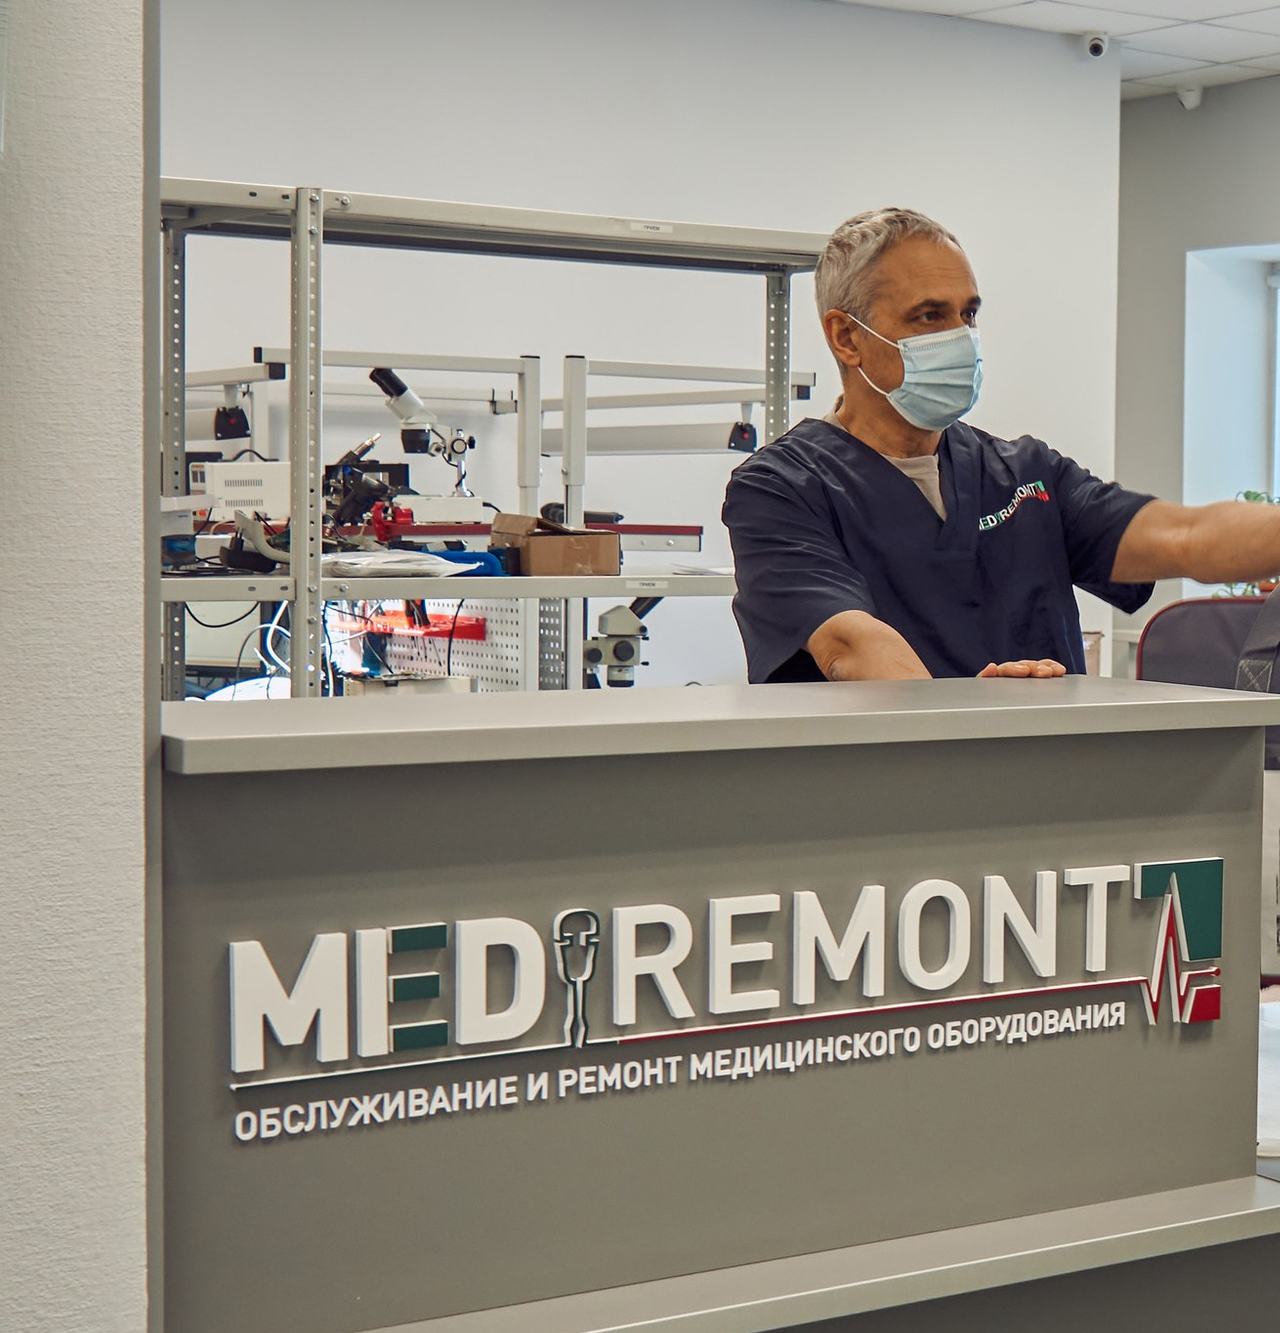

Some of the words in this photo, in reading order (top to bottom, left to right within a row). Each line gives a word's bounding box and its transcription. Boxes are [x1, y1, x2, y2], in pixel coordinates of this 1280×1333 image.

[235, 1075, 519, 1142] ОБСЛУЖИВАНИЕ
[527, 1071, 550, 1101] И
[558, 1054, 683, 1099] РЕМОНТ
[690, 1027, 921, 1082] МЕДИЦИНСКОГО
[926, 1001, 1126, 1050] ОБОРУДОВАНИЯ
